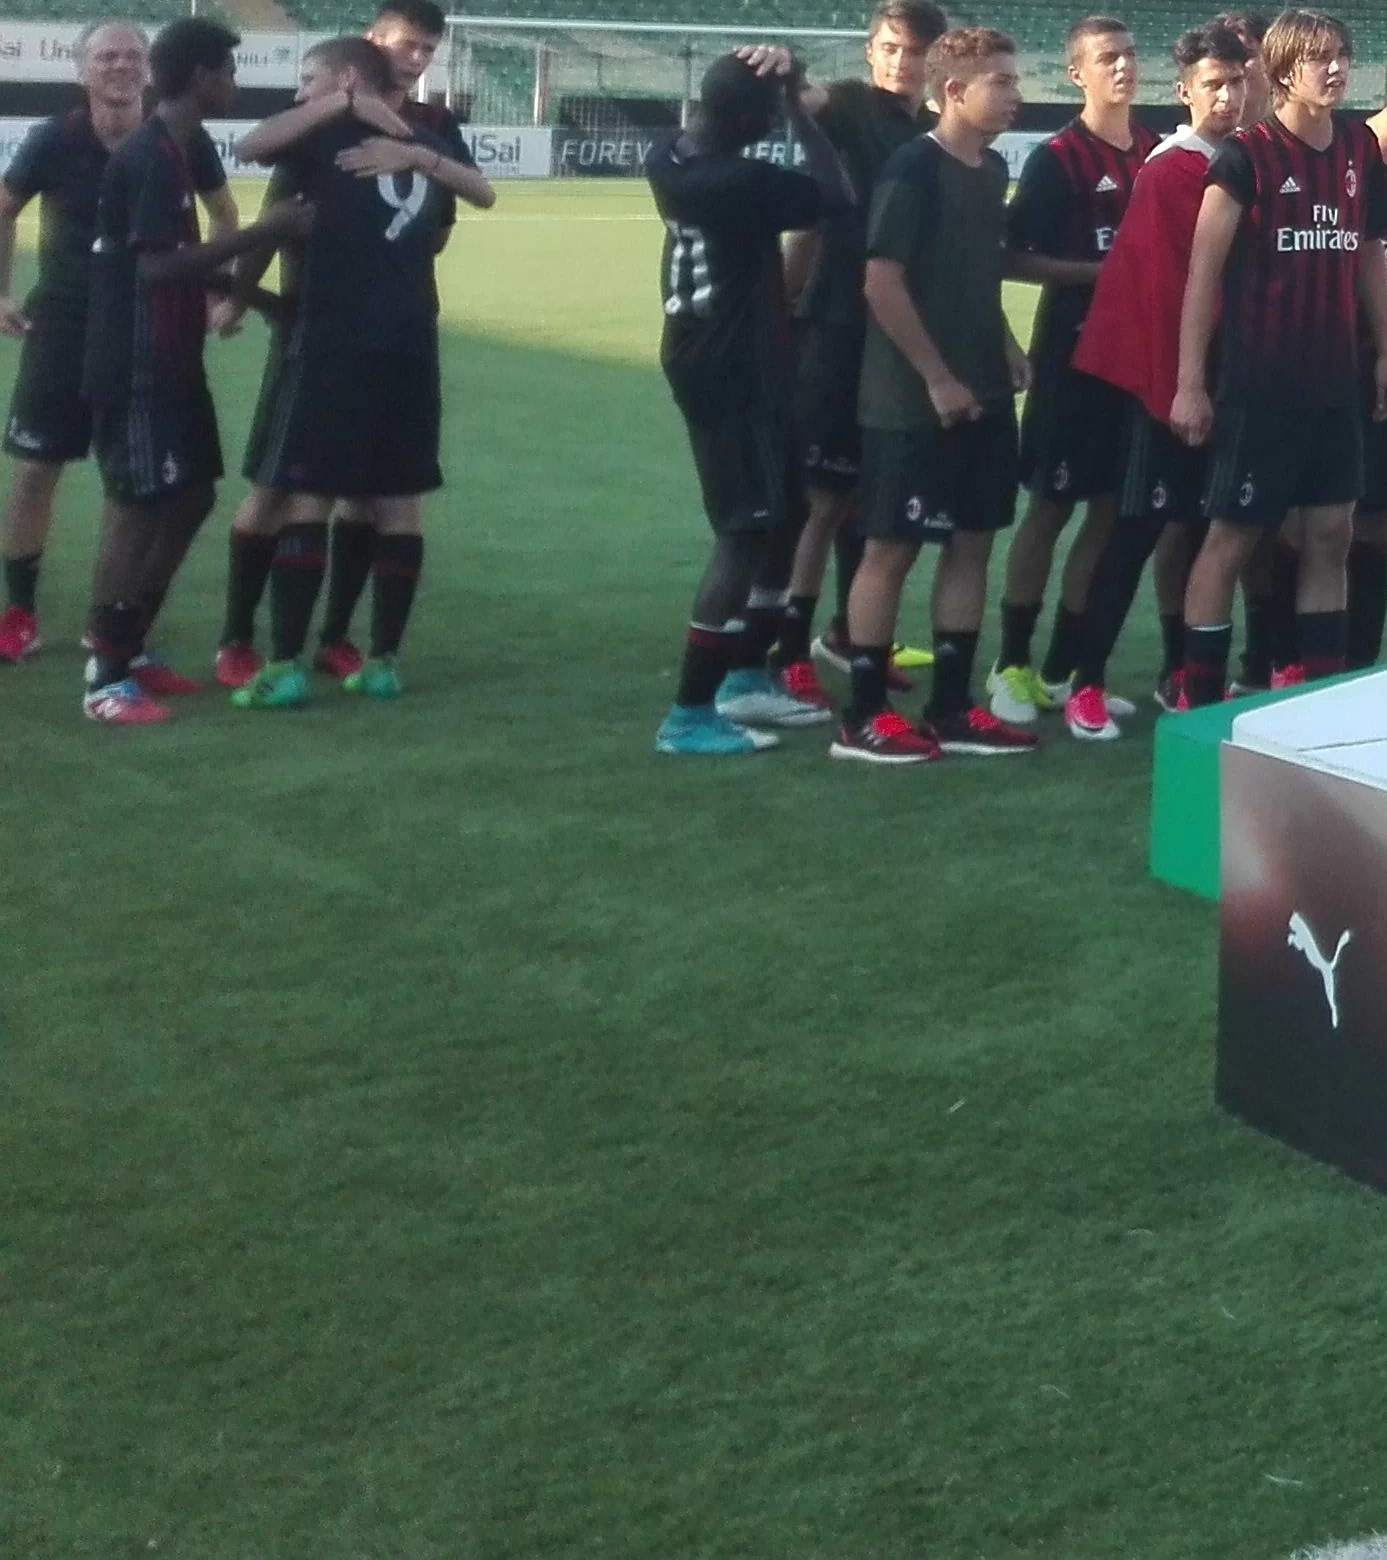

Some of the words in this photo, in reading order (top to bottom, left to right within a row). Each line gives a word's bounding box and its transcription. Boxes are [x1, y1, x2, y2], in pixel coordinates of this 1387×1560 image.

[560, 139, 652, 166] FOREV
[377, 170, 428, 241] 9
[1313, 205, 1338, 227] Fly
[1277, 224, 1359, 252] Emirates
